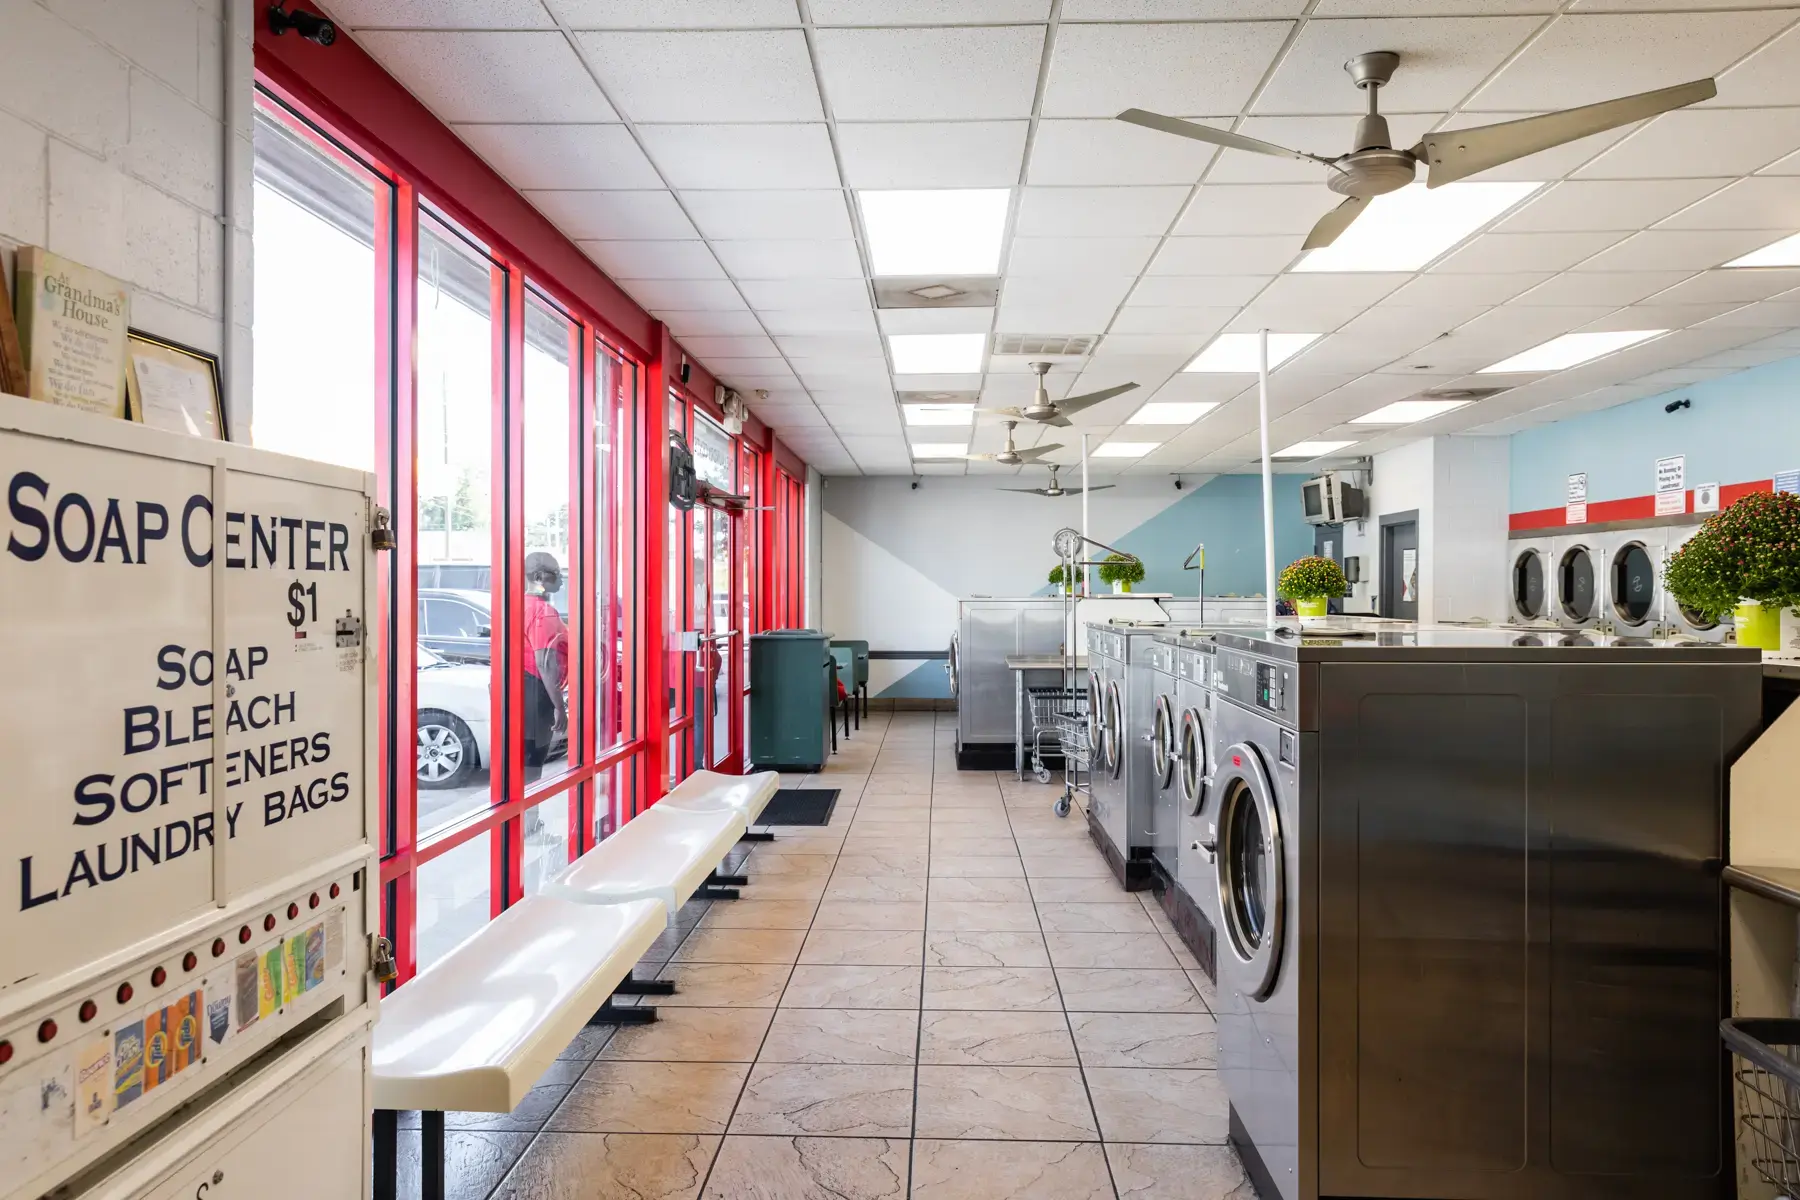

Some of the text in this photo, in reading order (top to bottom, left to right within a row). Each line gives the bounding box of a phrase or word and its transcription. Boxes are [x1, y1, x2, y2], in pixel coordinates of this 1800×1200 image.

[44, 275, 121, 317] Grandma's
[7, 471, 350, 572] SOAP CENTER
[287, 579, 318, 631] $1
[156, 644, 269, 691] SOAP
[123, 691, 296, 756] BLEACH
[72, 732, 331, 826] SOFTENERS
[19, 771, 350, 912] LAUNDRY BAGS
